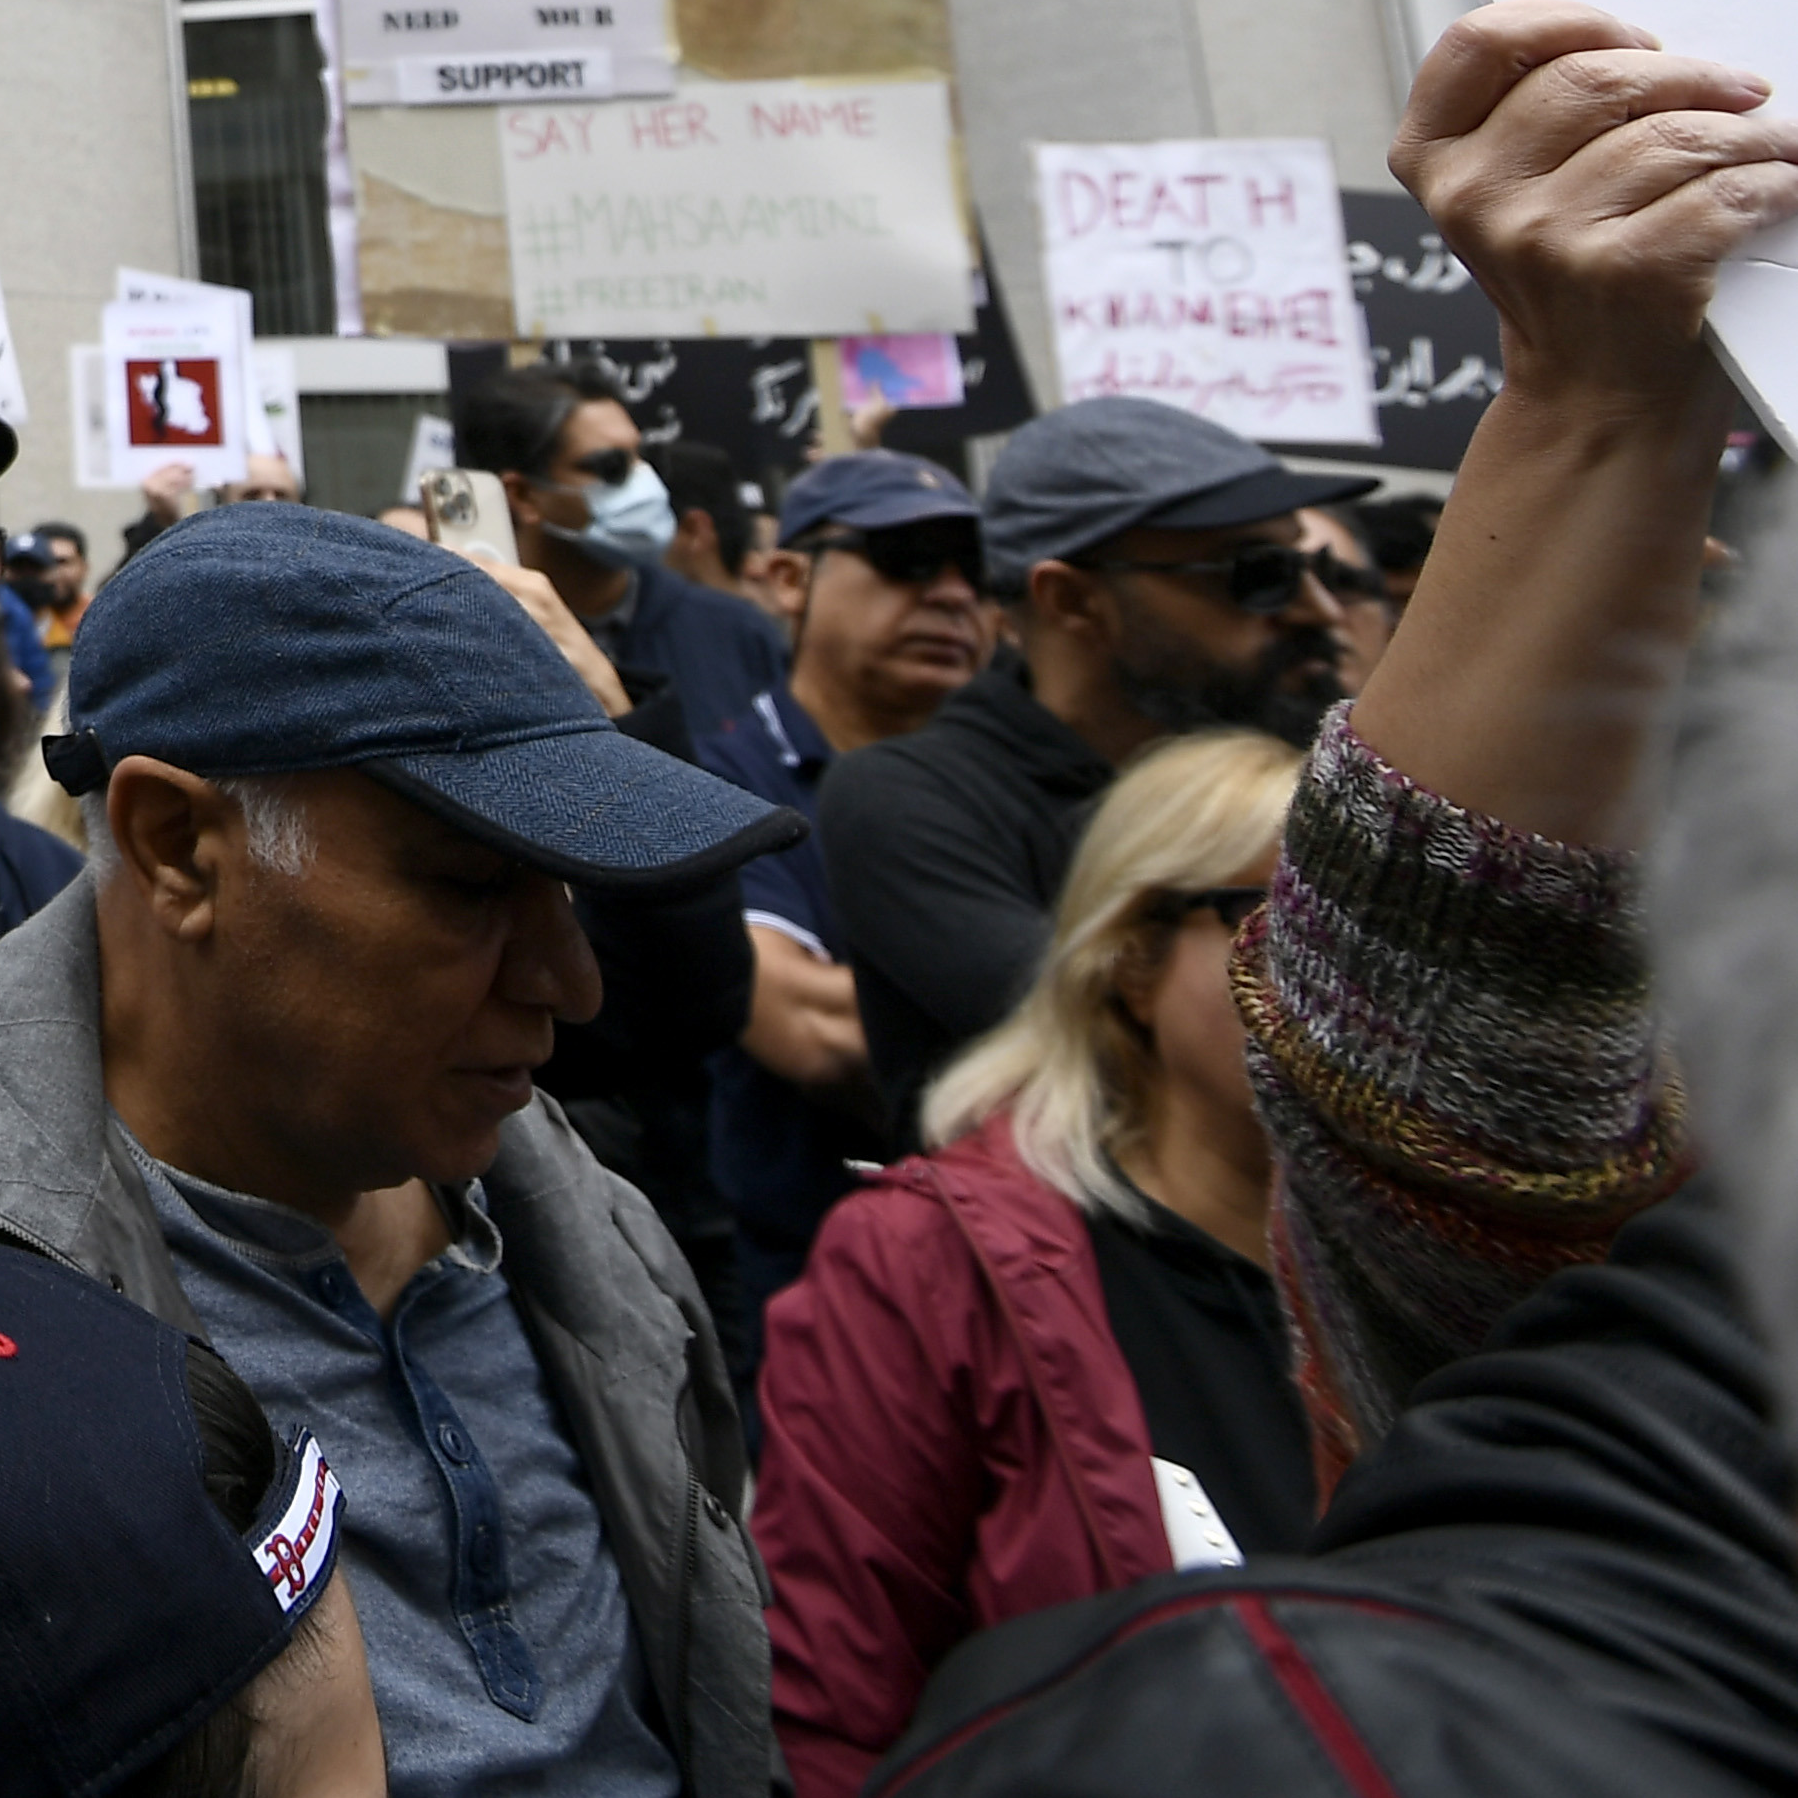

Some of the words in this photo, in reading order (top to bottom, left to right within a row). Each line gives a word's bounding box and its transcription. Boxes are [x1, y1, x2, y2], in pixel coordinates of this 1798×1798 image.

[382, 9, 459, 33] NEED
[536, 6, 614, 30] YOUR
[438, 60, 587, 93] SUPPORT
[506, 109, 595, 162] SAY
[630, 103, 717, 150] HER
[751, 98, 877, 140] NAME
[523, 190, 895, 264] #MAHSAAMINI
[1057, 168, 1297, 238] DEATH
[1147, 234, 1256, 285] TO
